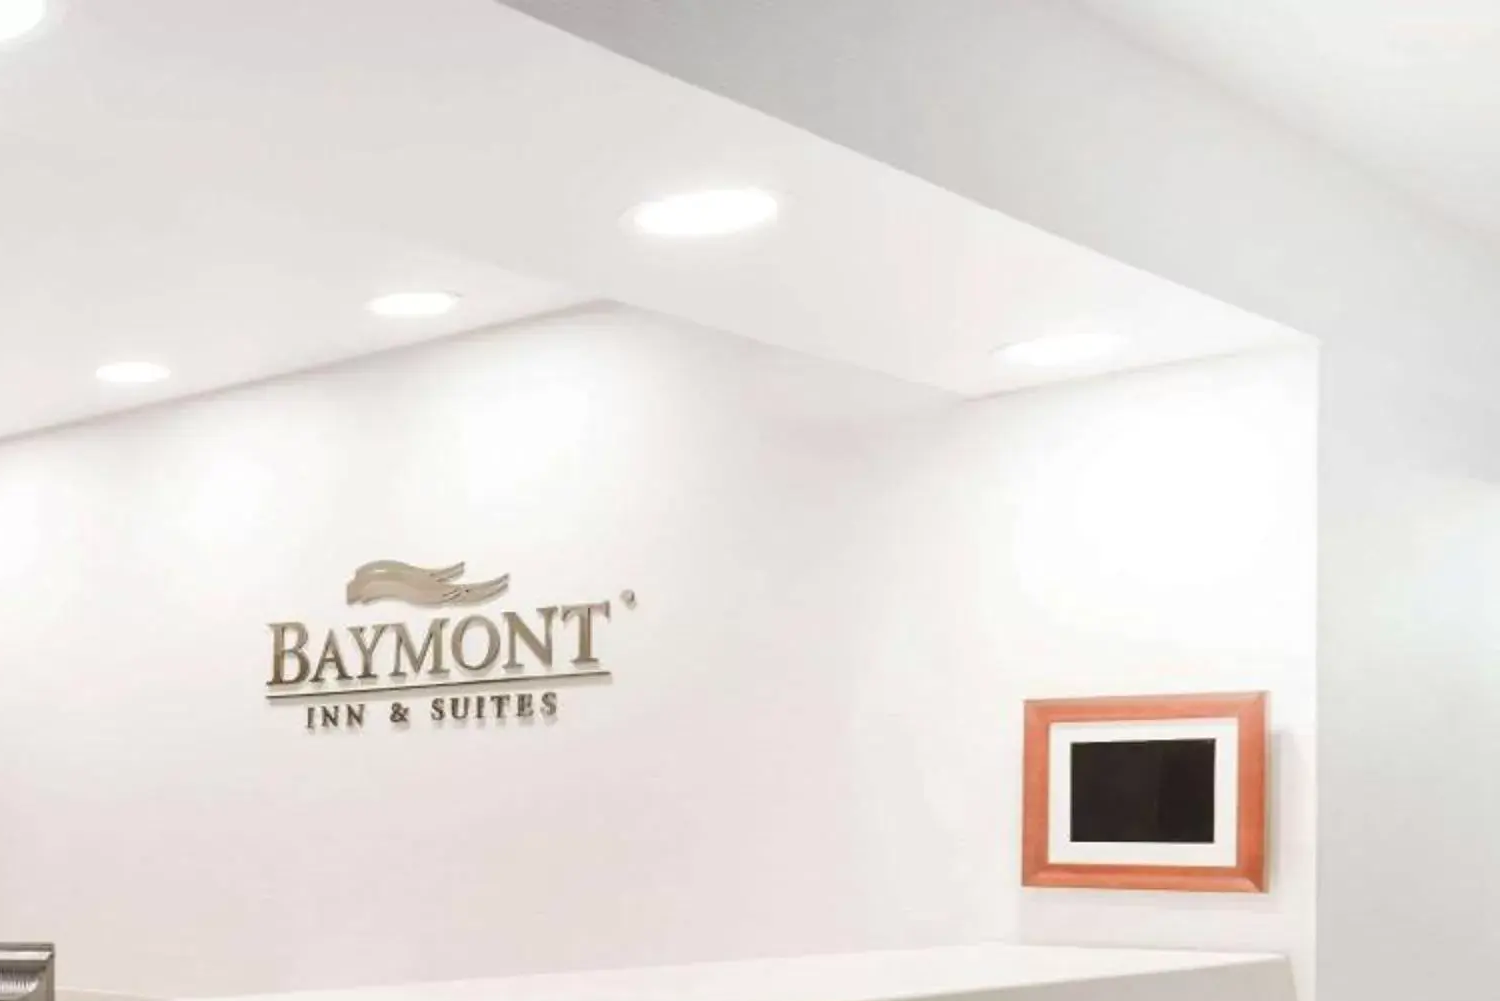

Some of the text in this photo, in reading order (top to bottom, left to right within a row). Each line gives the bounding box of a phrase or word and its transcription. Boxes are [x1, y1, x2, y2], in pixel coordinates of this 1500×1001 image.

[266, 601, 612, 686] BAYMONT
[306, 691, 559, 729] INN & SUITES
